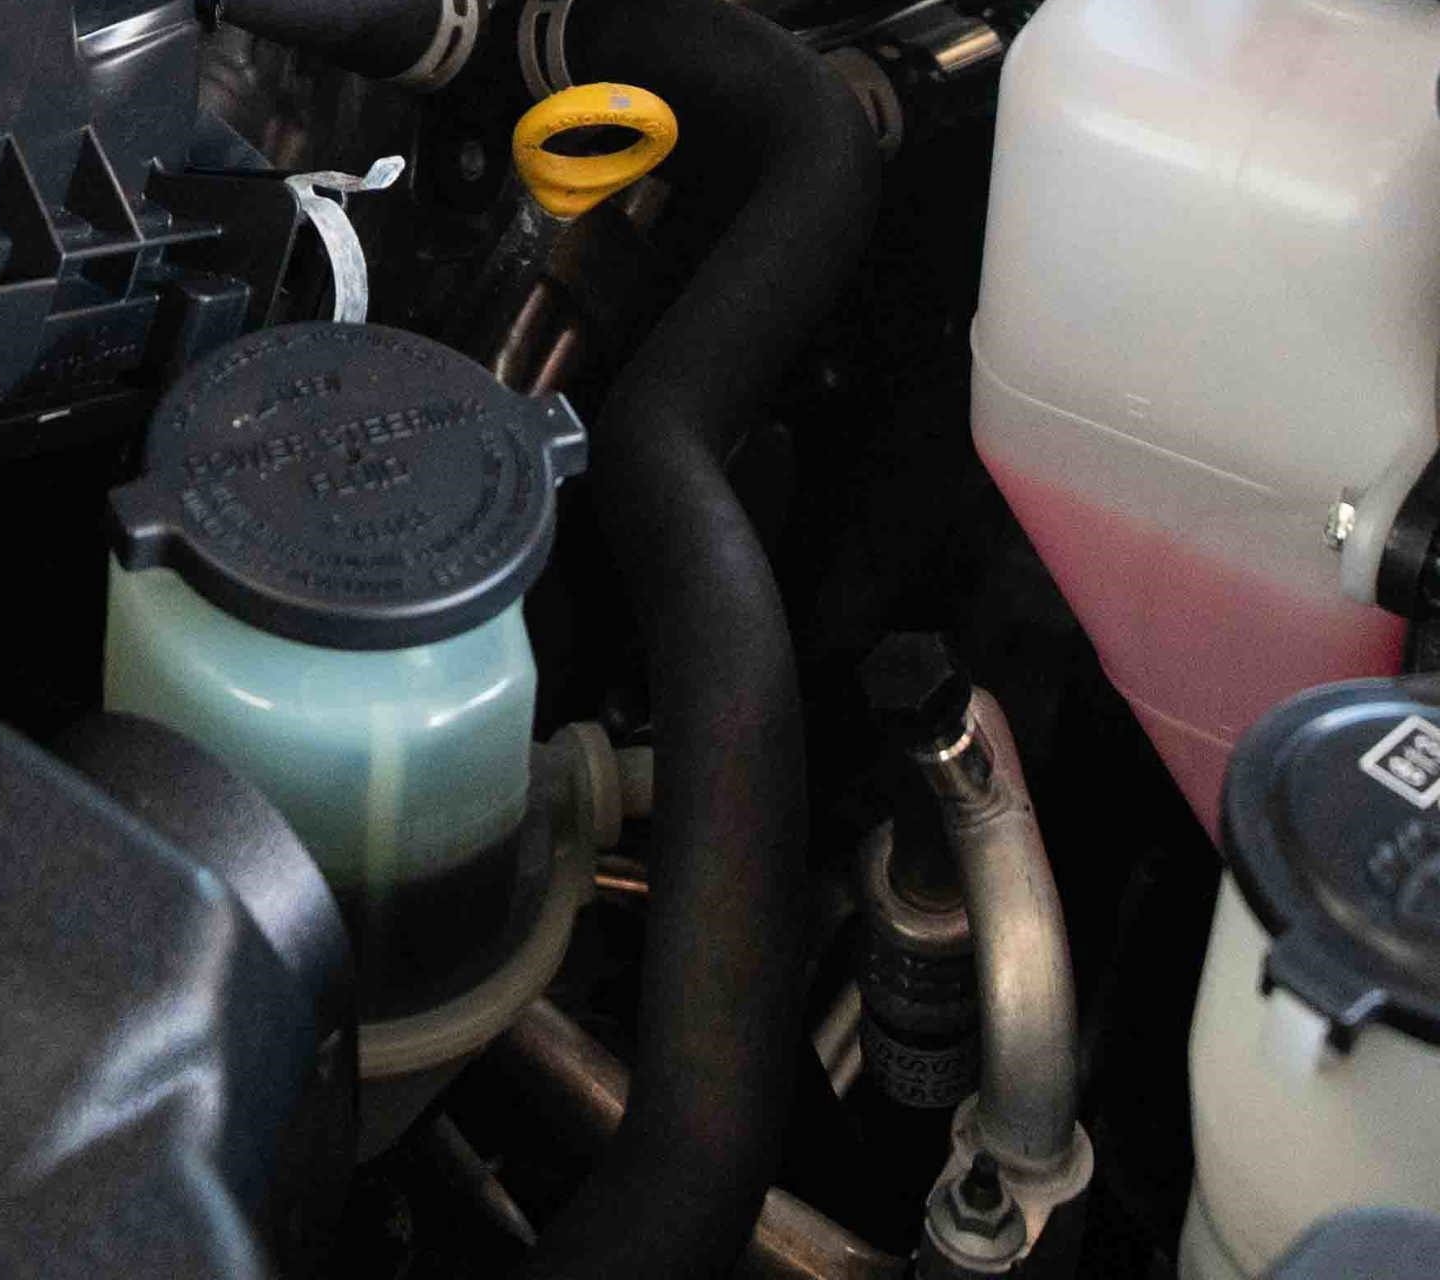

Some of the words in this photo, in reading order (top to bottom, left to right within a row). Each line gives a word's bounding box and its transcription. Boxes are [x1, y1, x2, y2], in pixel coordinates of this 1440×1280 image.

[182, 433, 315, 478] POWER
[317, 397, 486, 447] STEERING
[308, 455, 411, 499] FLUID
